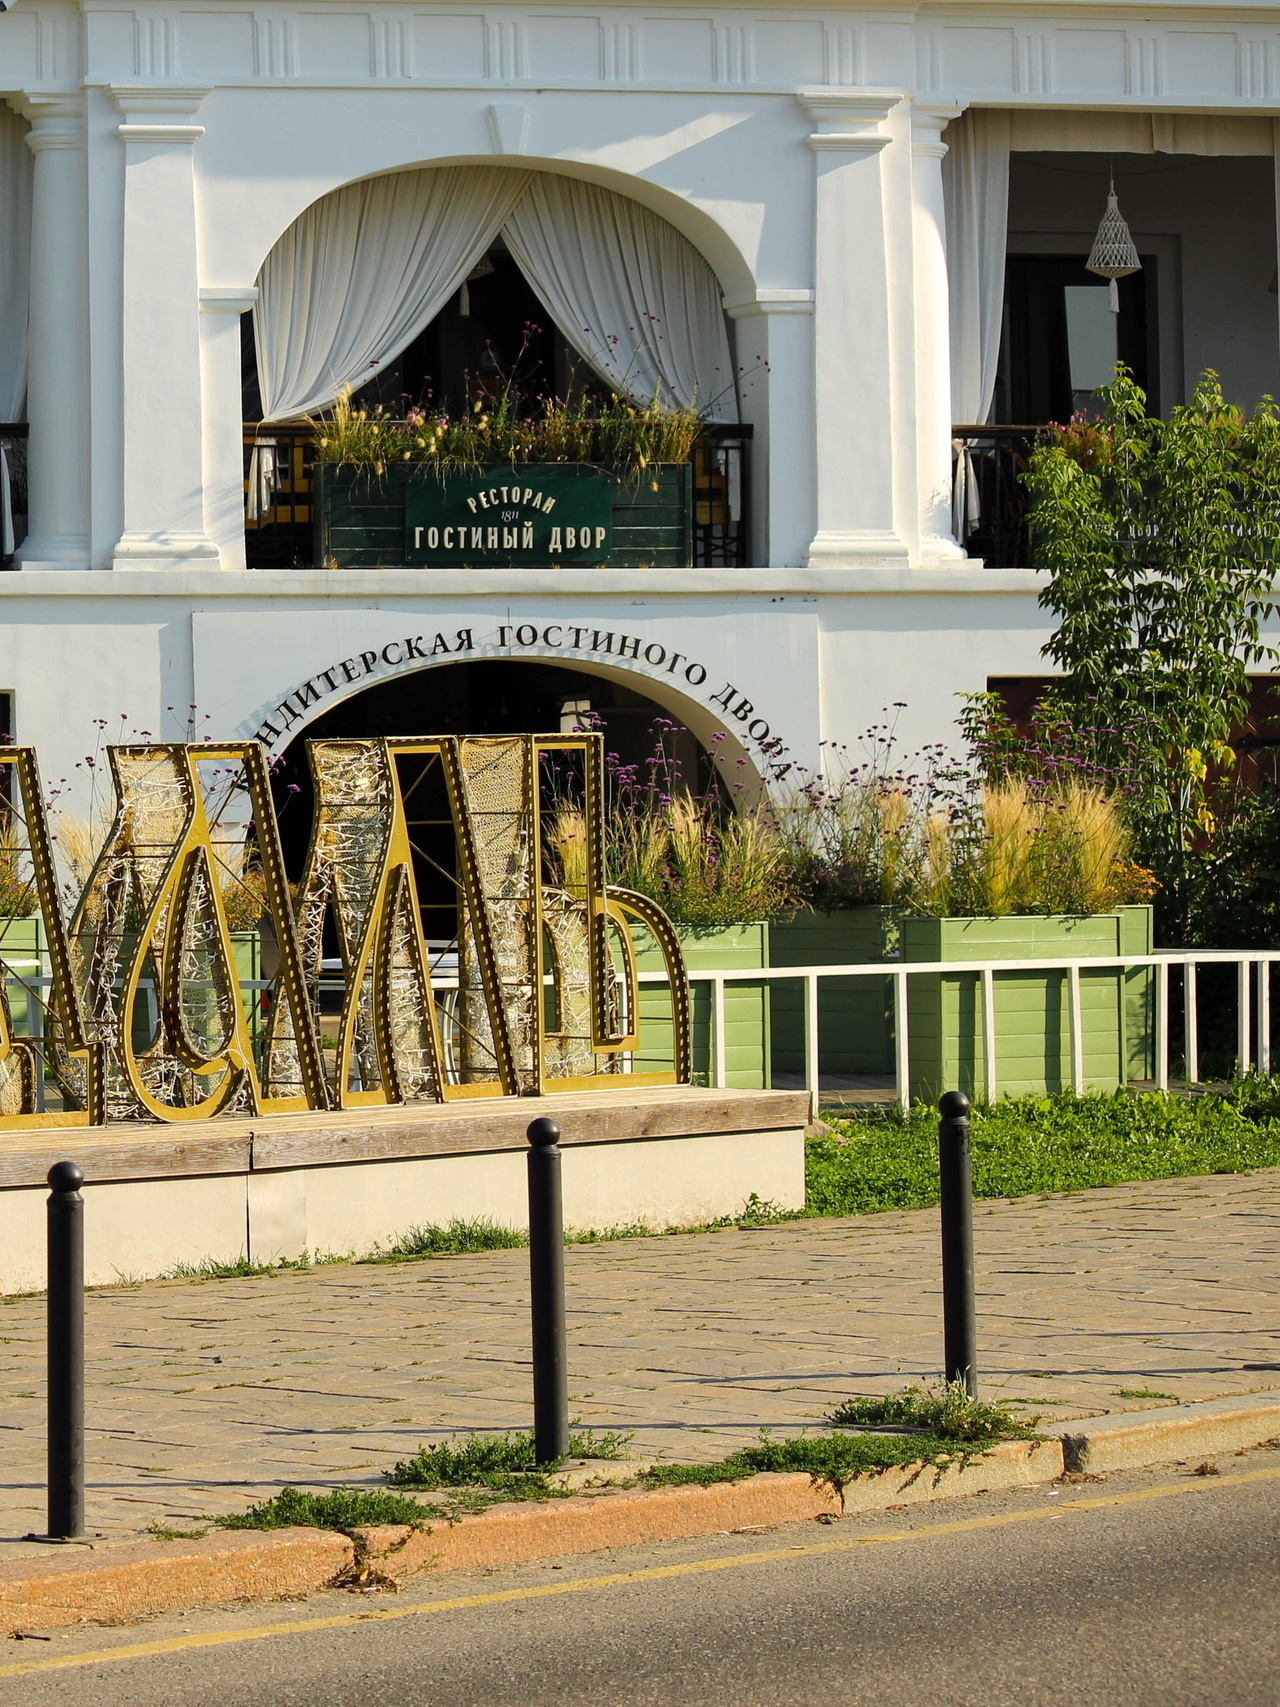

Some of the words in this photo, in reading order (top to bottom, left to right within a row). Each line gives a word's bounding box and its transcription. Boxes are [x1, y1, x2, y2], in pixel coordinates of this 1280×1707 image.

[467, 486, 556, 514] РЕСТОРАН
[501, 510, 520, 522] 1811
[414, 521, 534, 549] ГОСТИНЫЙ
[549, 526, 606, 553] ДВОР
[230, 628, 476, 795] КНДИТЕРСКАЯ
[497, 624, 707, 686] ГОСТИНОГО
